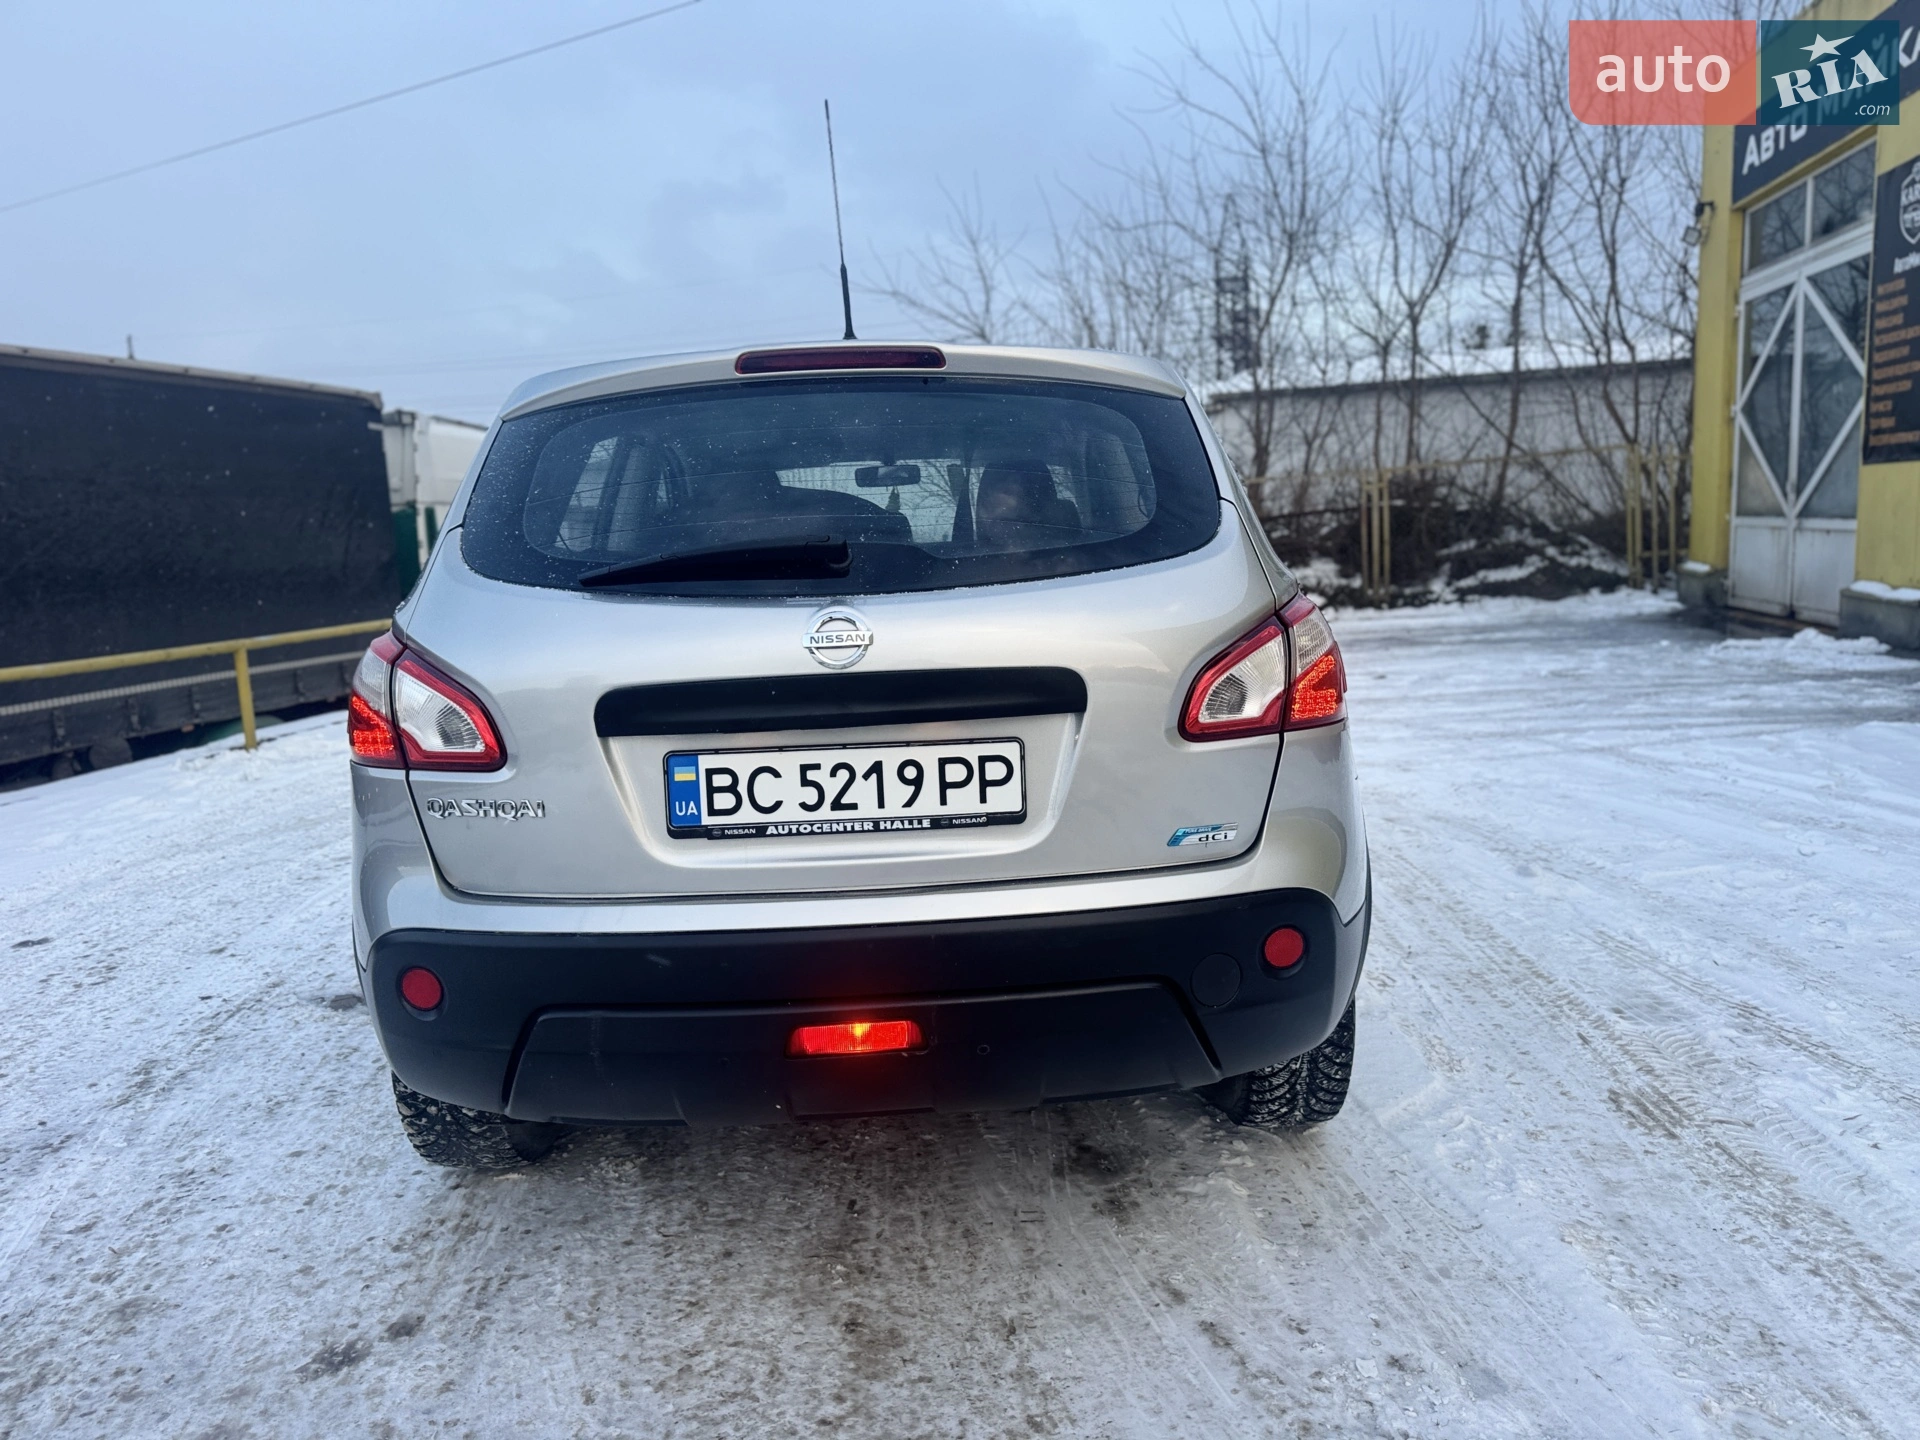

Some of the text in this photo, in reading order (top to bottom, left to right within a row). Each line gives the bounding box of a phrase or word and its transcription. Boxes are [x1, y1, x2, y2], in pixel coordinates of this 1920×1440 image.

[809, 633, 866, 645] NISSAN
[705, 754, 1015, 817] BC 5219 PP
[427, 797, 545, 821] QASHQAI
[676, 801, 698, 816] UA
[724, 816, 984, 836] NISSAN AUTOCENTER HALLE NISSAN
[1198, 832, 1228, 842] dCi
